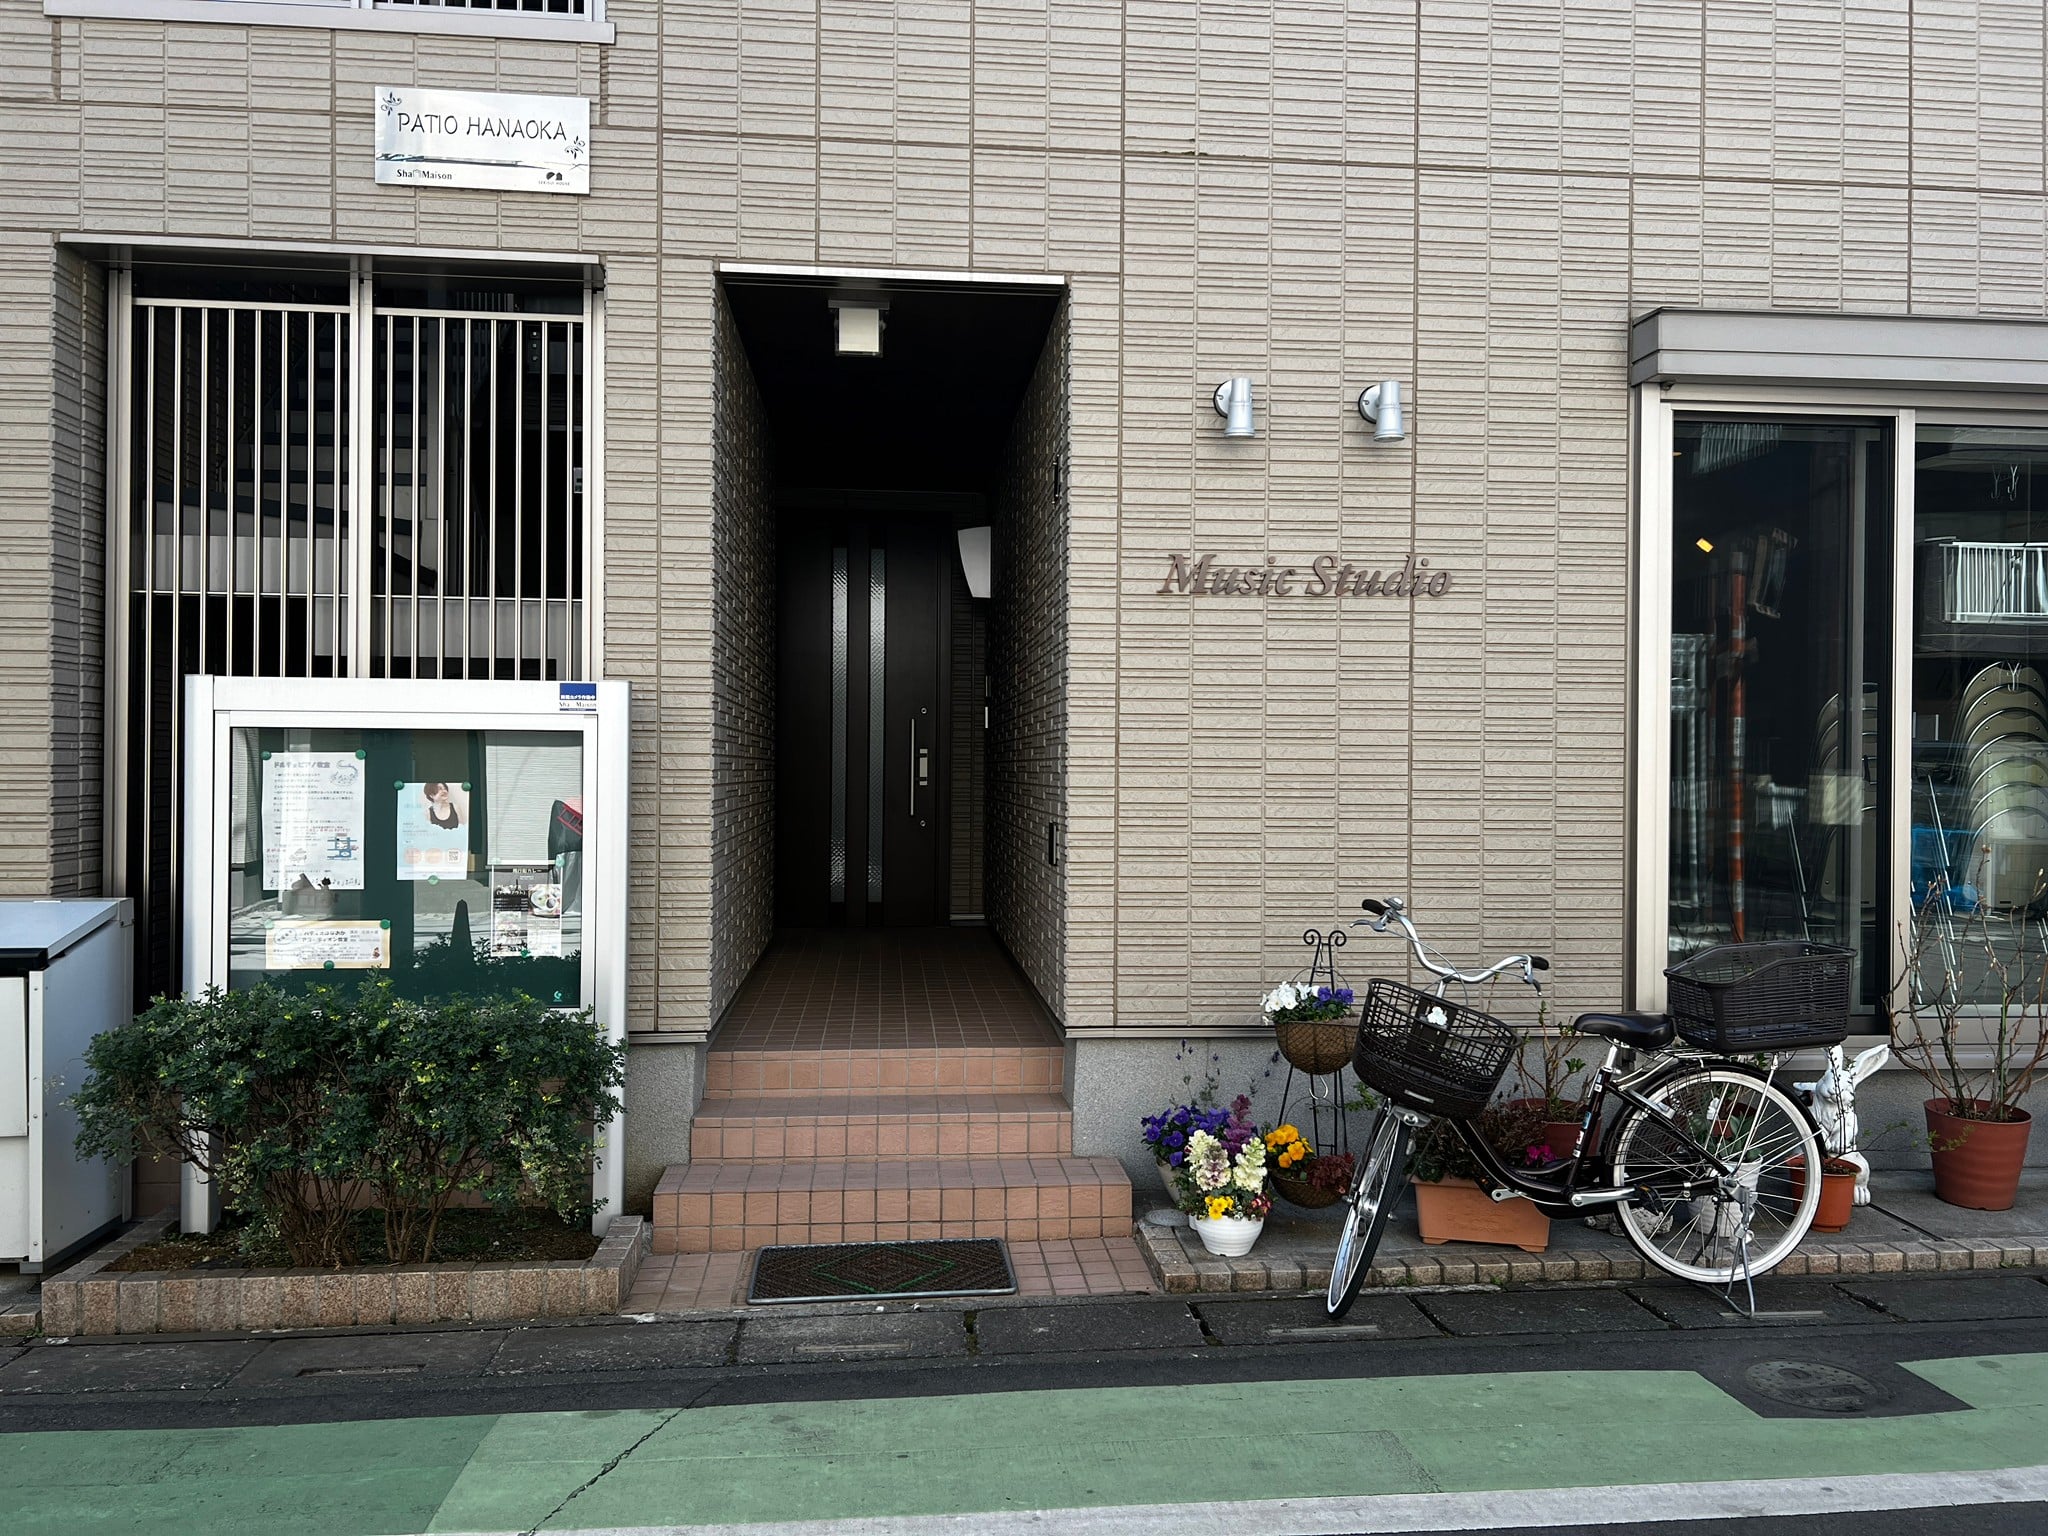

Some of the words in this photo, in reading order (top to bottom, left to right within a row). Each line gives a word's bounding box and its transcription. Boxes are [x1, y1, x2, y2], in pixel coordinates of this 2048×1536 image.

[397, 112, 458, 135] PATIO
[466, 116, 567, 141] HANAOKA
[421, 170, 453, 180] Maison
[1156, 553, 1297, 597] Music
[1305, 553, 1453, 597] Studio
